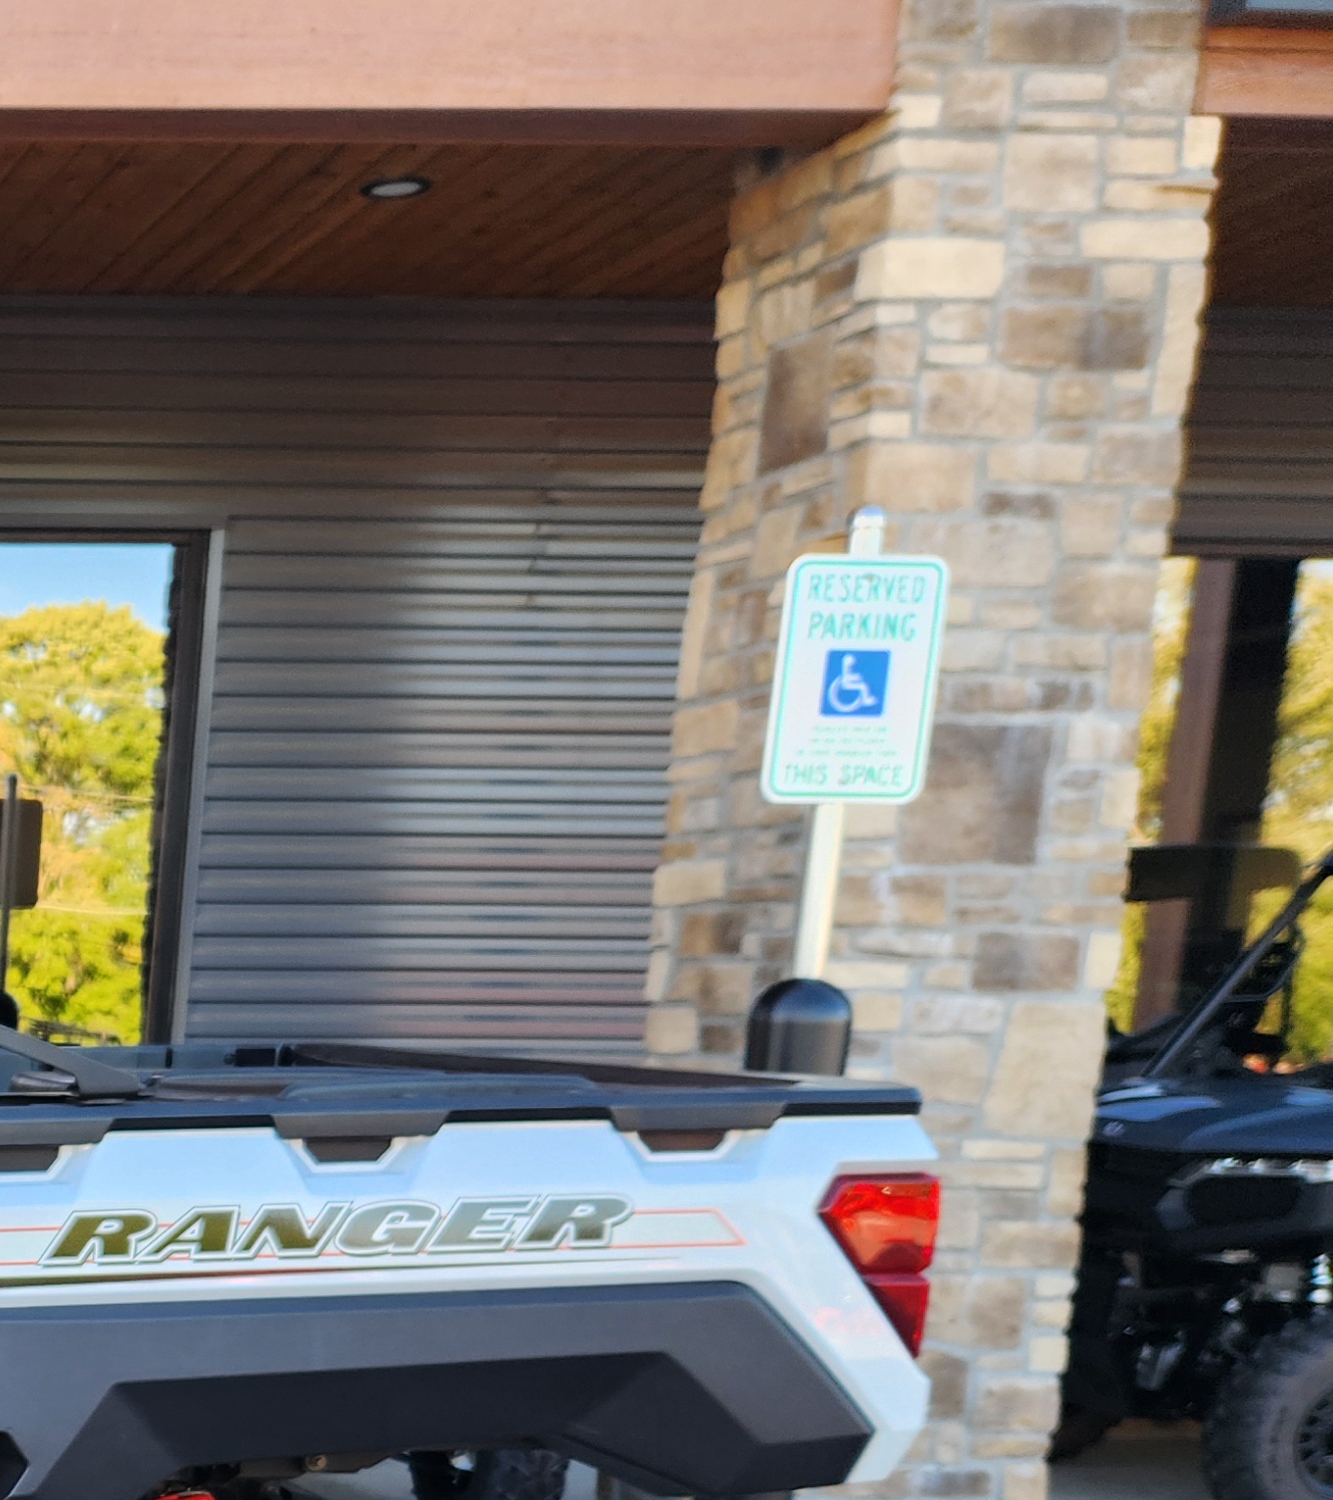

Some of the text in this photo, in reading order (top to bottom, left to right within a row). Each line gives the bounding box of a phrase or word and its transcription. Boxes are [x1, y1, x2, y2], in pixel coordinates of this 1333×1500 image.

[807, 573, 926, 605] RESERVED
[807, 612, 917, 642] PARKING
[784, 764, 905, 787] THIS SPACE
[36, 1194, 632, 1266] RANGER
